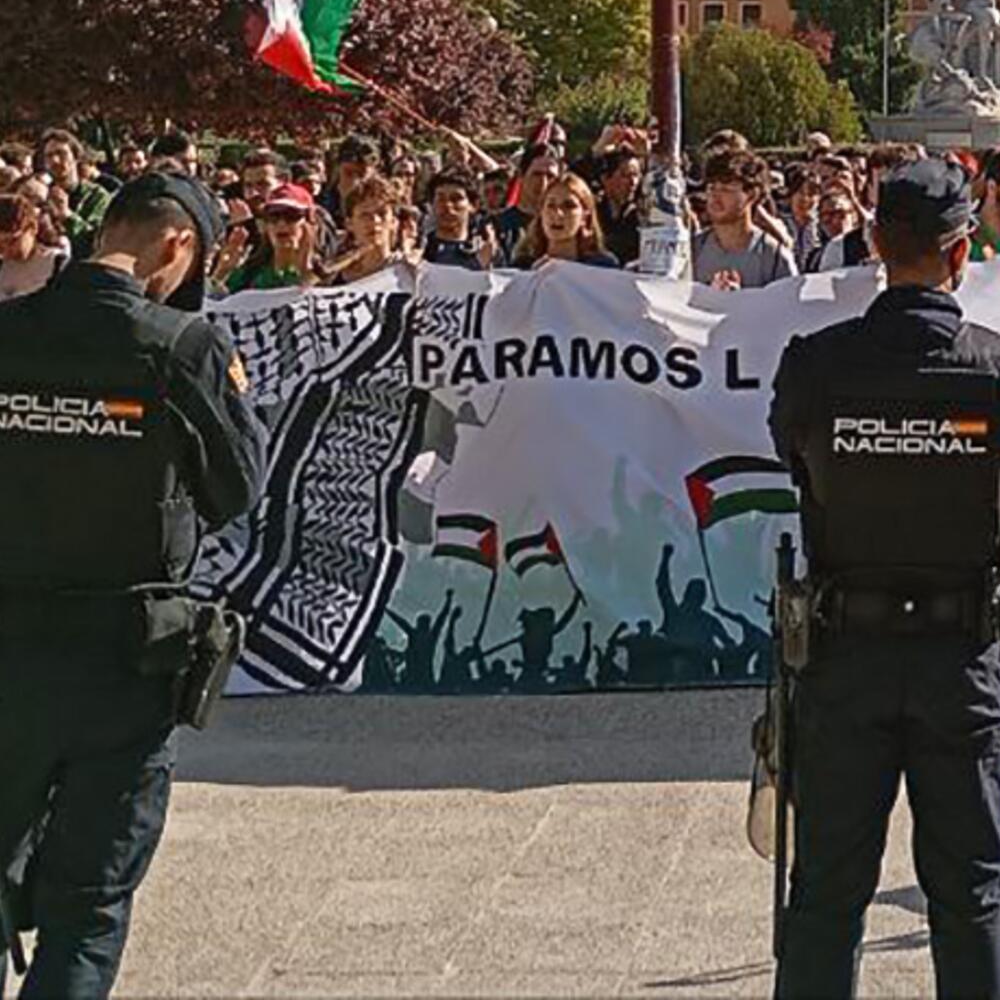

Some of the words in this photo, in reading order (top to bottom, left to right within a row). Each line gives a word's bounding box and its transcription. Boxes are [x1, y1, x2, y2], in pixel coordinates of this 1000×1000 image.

[419, 335, 703, 390] PARAMOS
[834, 417, 957, 436] POLICIA
[834, 436, 987, 454] NACIONAL
